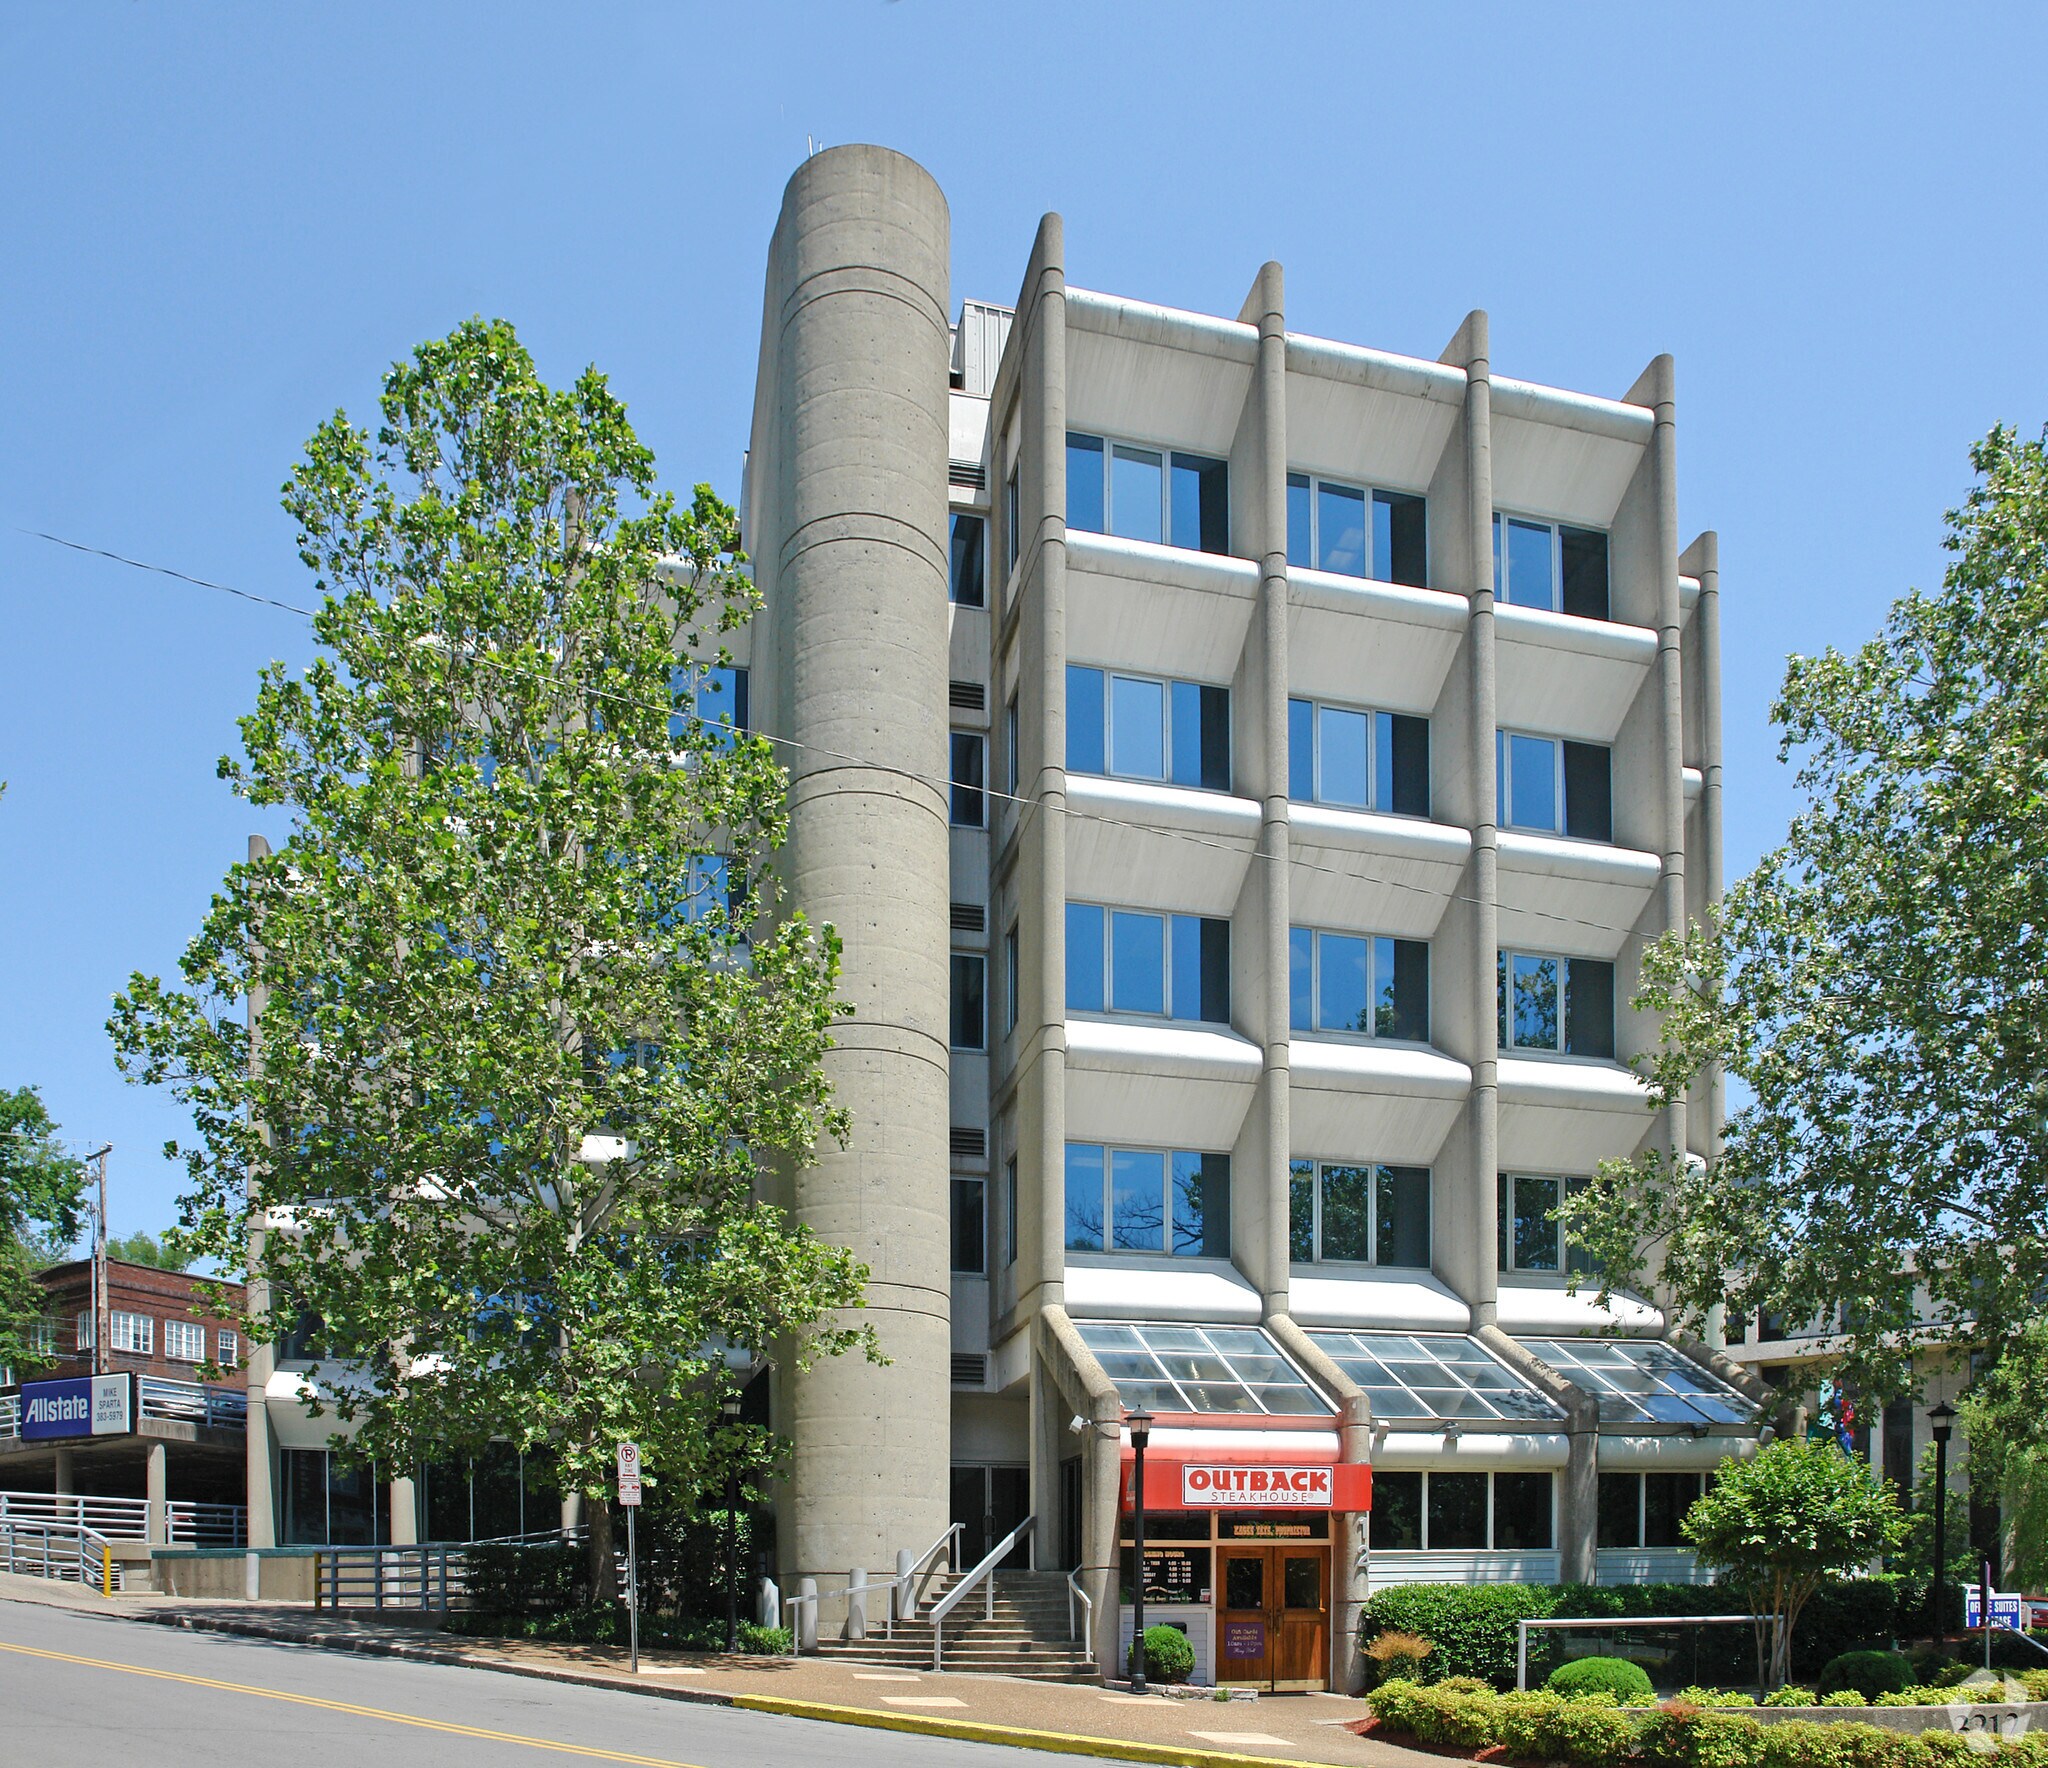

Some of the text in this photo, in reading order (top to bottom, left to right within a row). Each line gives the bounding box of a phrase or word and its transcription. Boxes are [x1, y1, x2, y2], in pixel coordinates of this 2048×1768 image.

[103, 1387, 117, 1397] MIKE
[25, 1395, 88, 1423] Allstate
[98, 1400, 121, 1410] SPARTA
[1188, 1469, 1328, 1493] OUTBACK
[1211, 1491, 1308, 1502] STEAKHOUSE
[1994, 1600, 2018, 1613] SUITES
